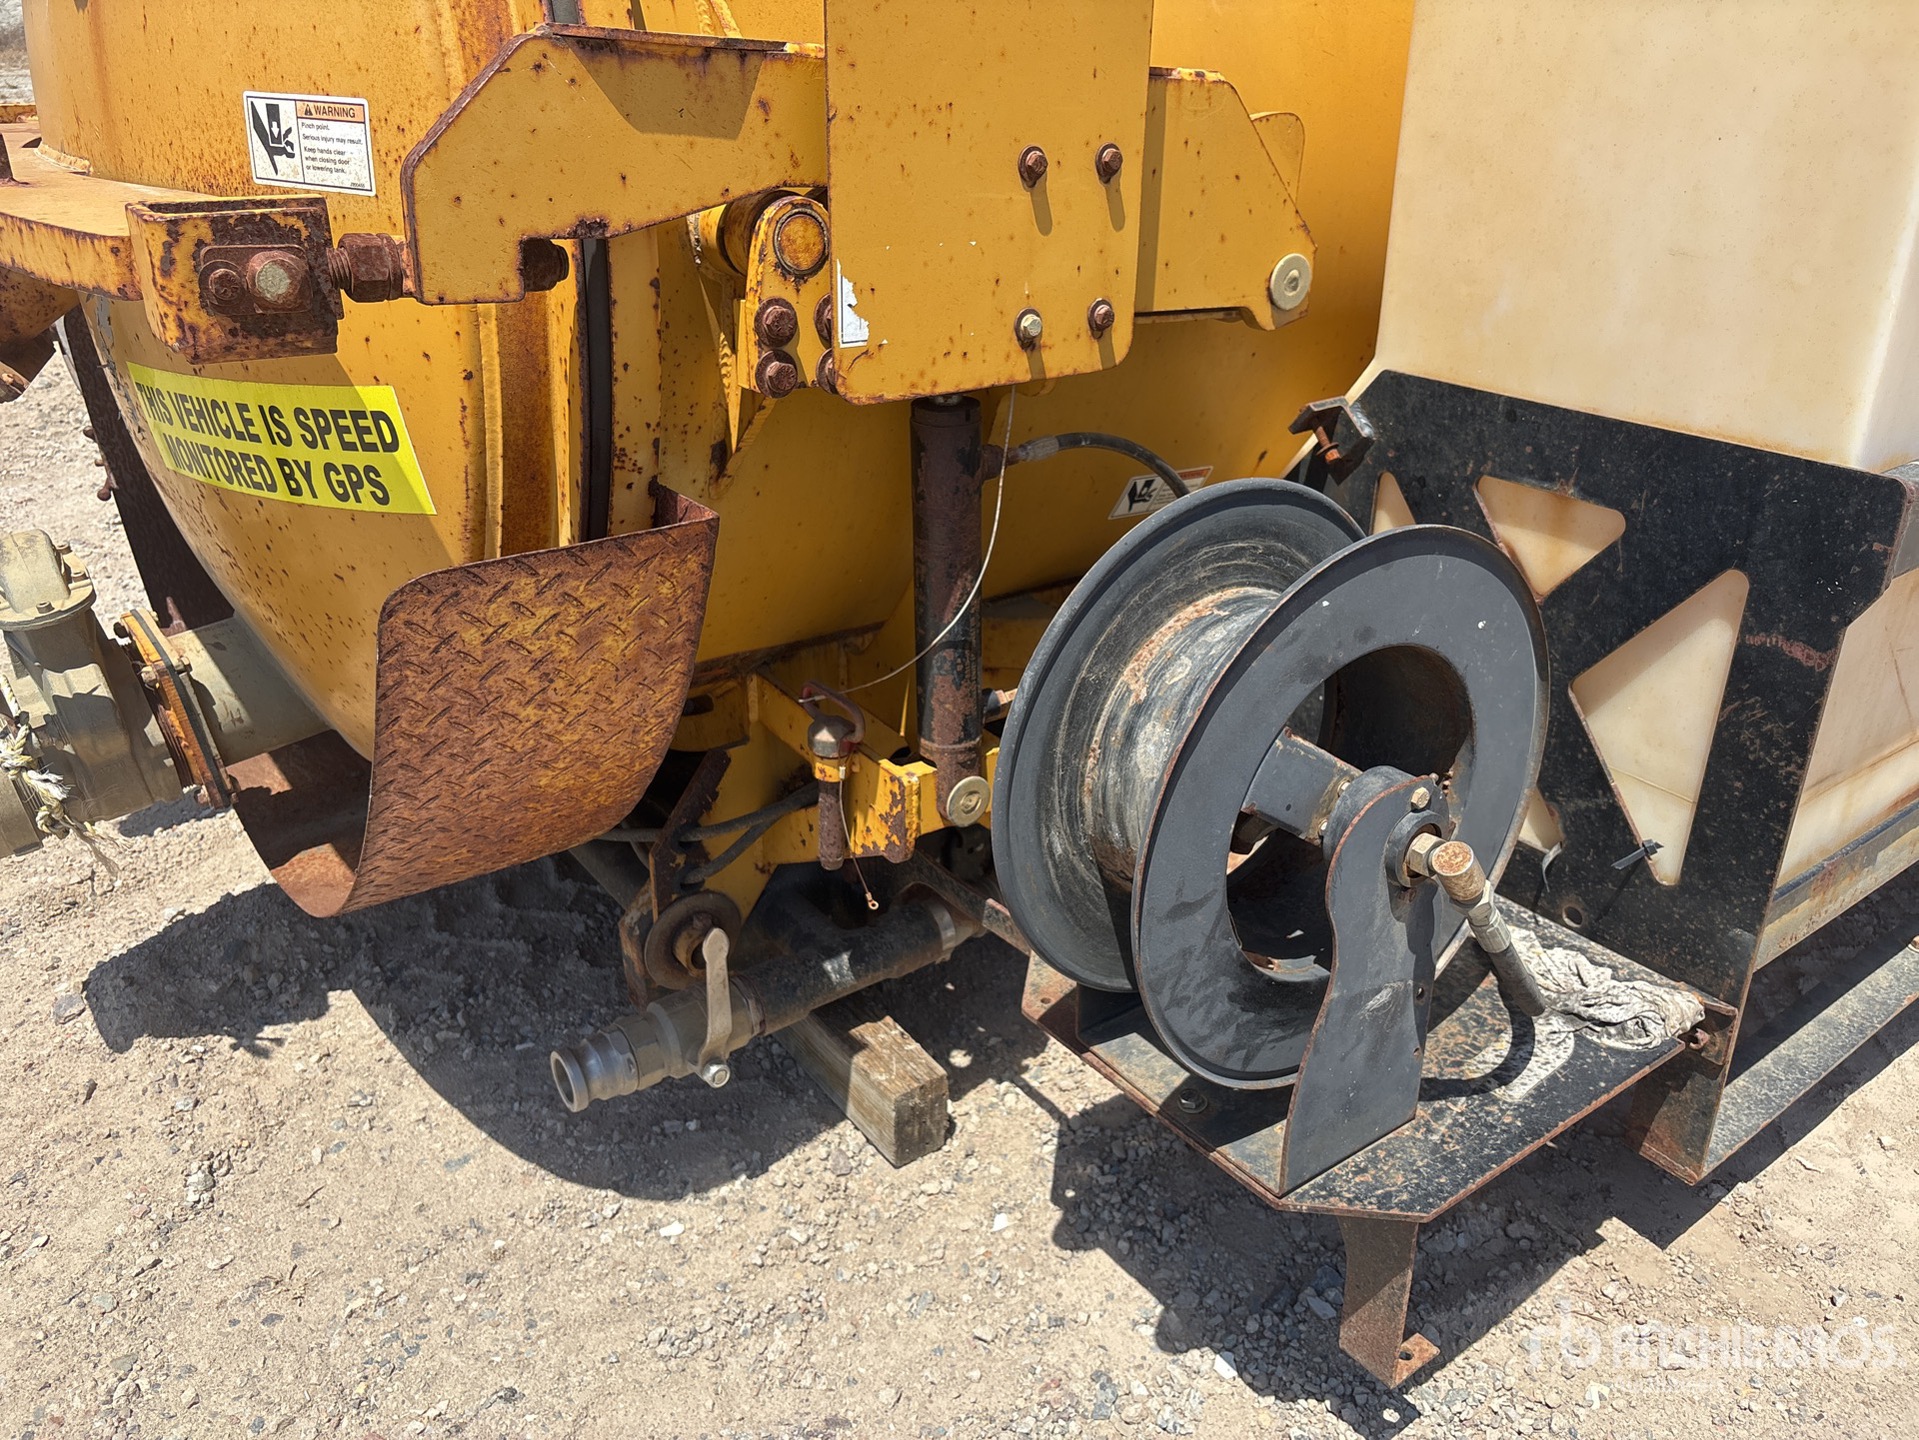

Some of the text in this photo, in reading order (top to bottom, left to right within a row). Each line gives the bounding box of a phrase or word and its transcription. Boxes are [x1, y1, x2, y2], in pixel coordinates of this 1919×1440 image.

[313, 105, 356, 118] WARNING
[302, 133, 320, 141] Serious
[321, 135, 335, 143] injury
[335, 137, 346, 145] may
[304, 146, 316, 154] Keep
[317, 147, 332, 155] hands
[318, 156, 337, 165] closing
[312, 164, 333, 174] lowering
[135, 381, 400, 453] THIS VEHICLE IS SPEED
[162, 432, 390, 506] MONITORED BY GPS
